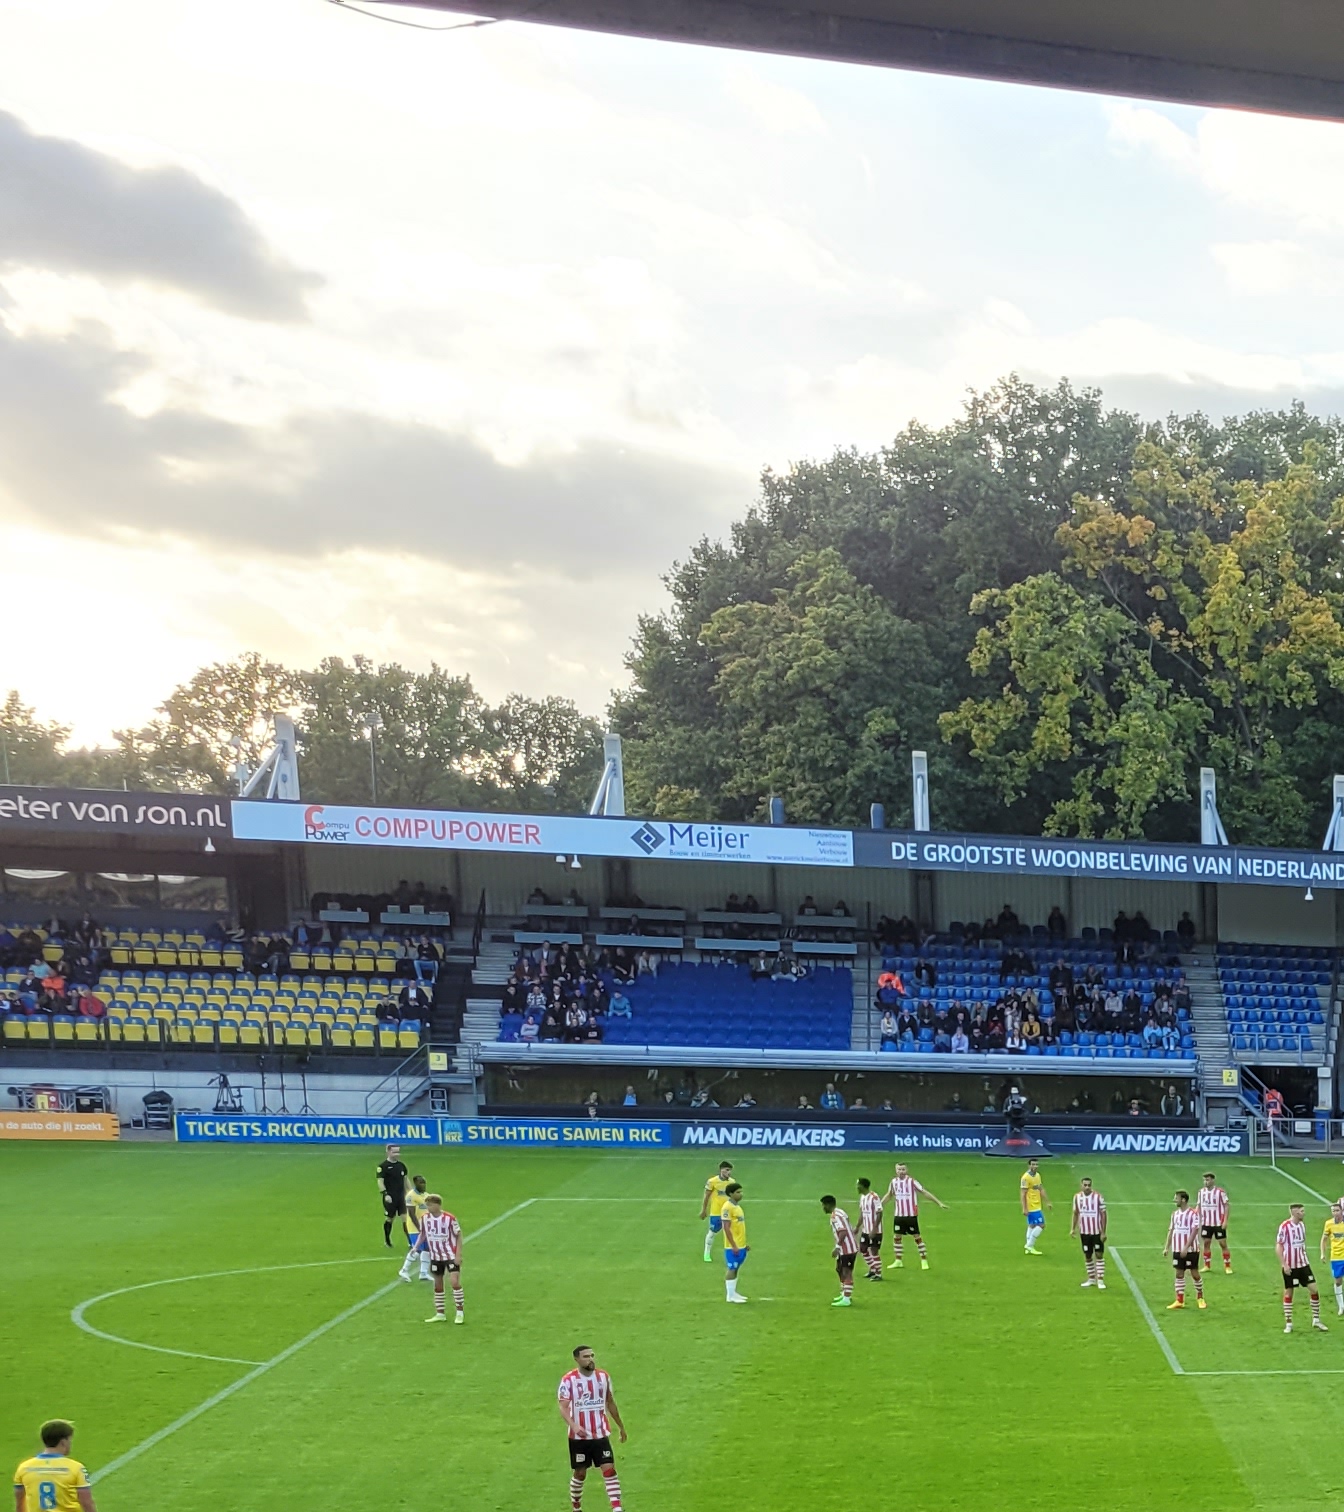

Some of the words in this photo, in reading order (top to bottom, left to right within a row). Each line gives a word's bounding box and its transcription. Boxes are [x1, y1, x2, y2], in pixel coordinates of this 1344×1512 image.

[67, 801, 129, 823] van
[135, 804, 227, 828] son.nl
[305, 824, 350, 841] Power
[355, 815, 542, 845] COMPUPOWER
[668, 823, 750, 853] Meijer
[891, 841, 917, 862] DE
[922, 843, 1026, 868] GROOTSTE
[1032, 847, 1187, 874] WOONBELEVING
[1193, 853, 1232, 876] VAN
[185, 1120, 432, 1140] TICKETS.RKCWAALWIJK.NL
[445, 1131, 464, 1143] RKC
[468, 1125, 559, 1141] STICHTING
[563, 1126, 625, 1142] SAMEN
[629, 1127, 662, 1143] RKC
[682, 1126, 846, 1147] MANDEMAKERS
[894, 1134, 919, 1148] hét
[922, 1134, 953, 1148] huis
[955, 1137, 982, 1148] van
[1092, 1133, 1242, 1153] MANDEMAKERS
[39, 1481, 57, 1510] 8
